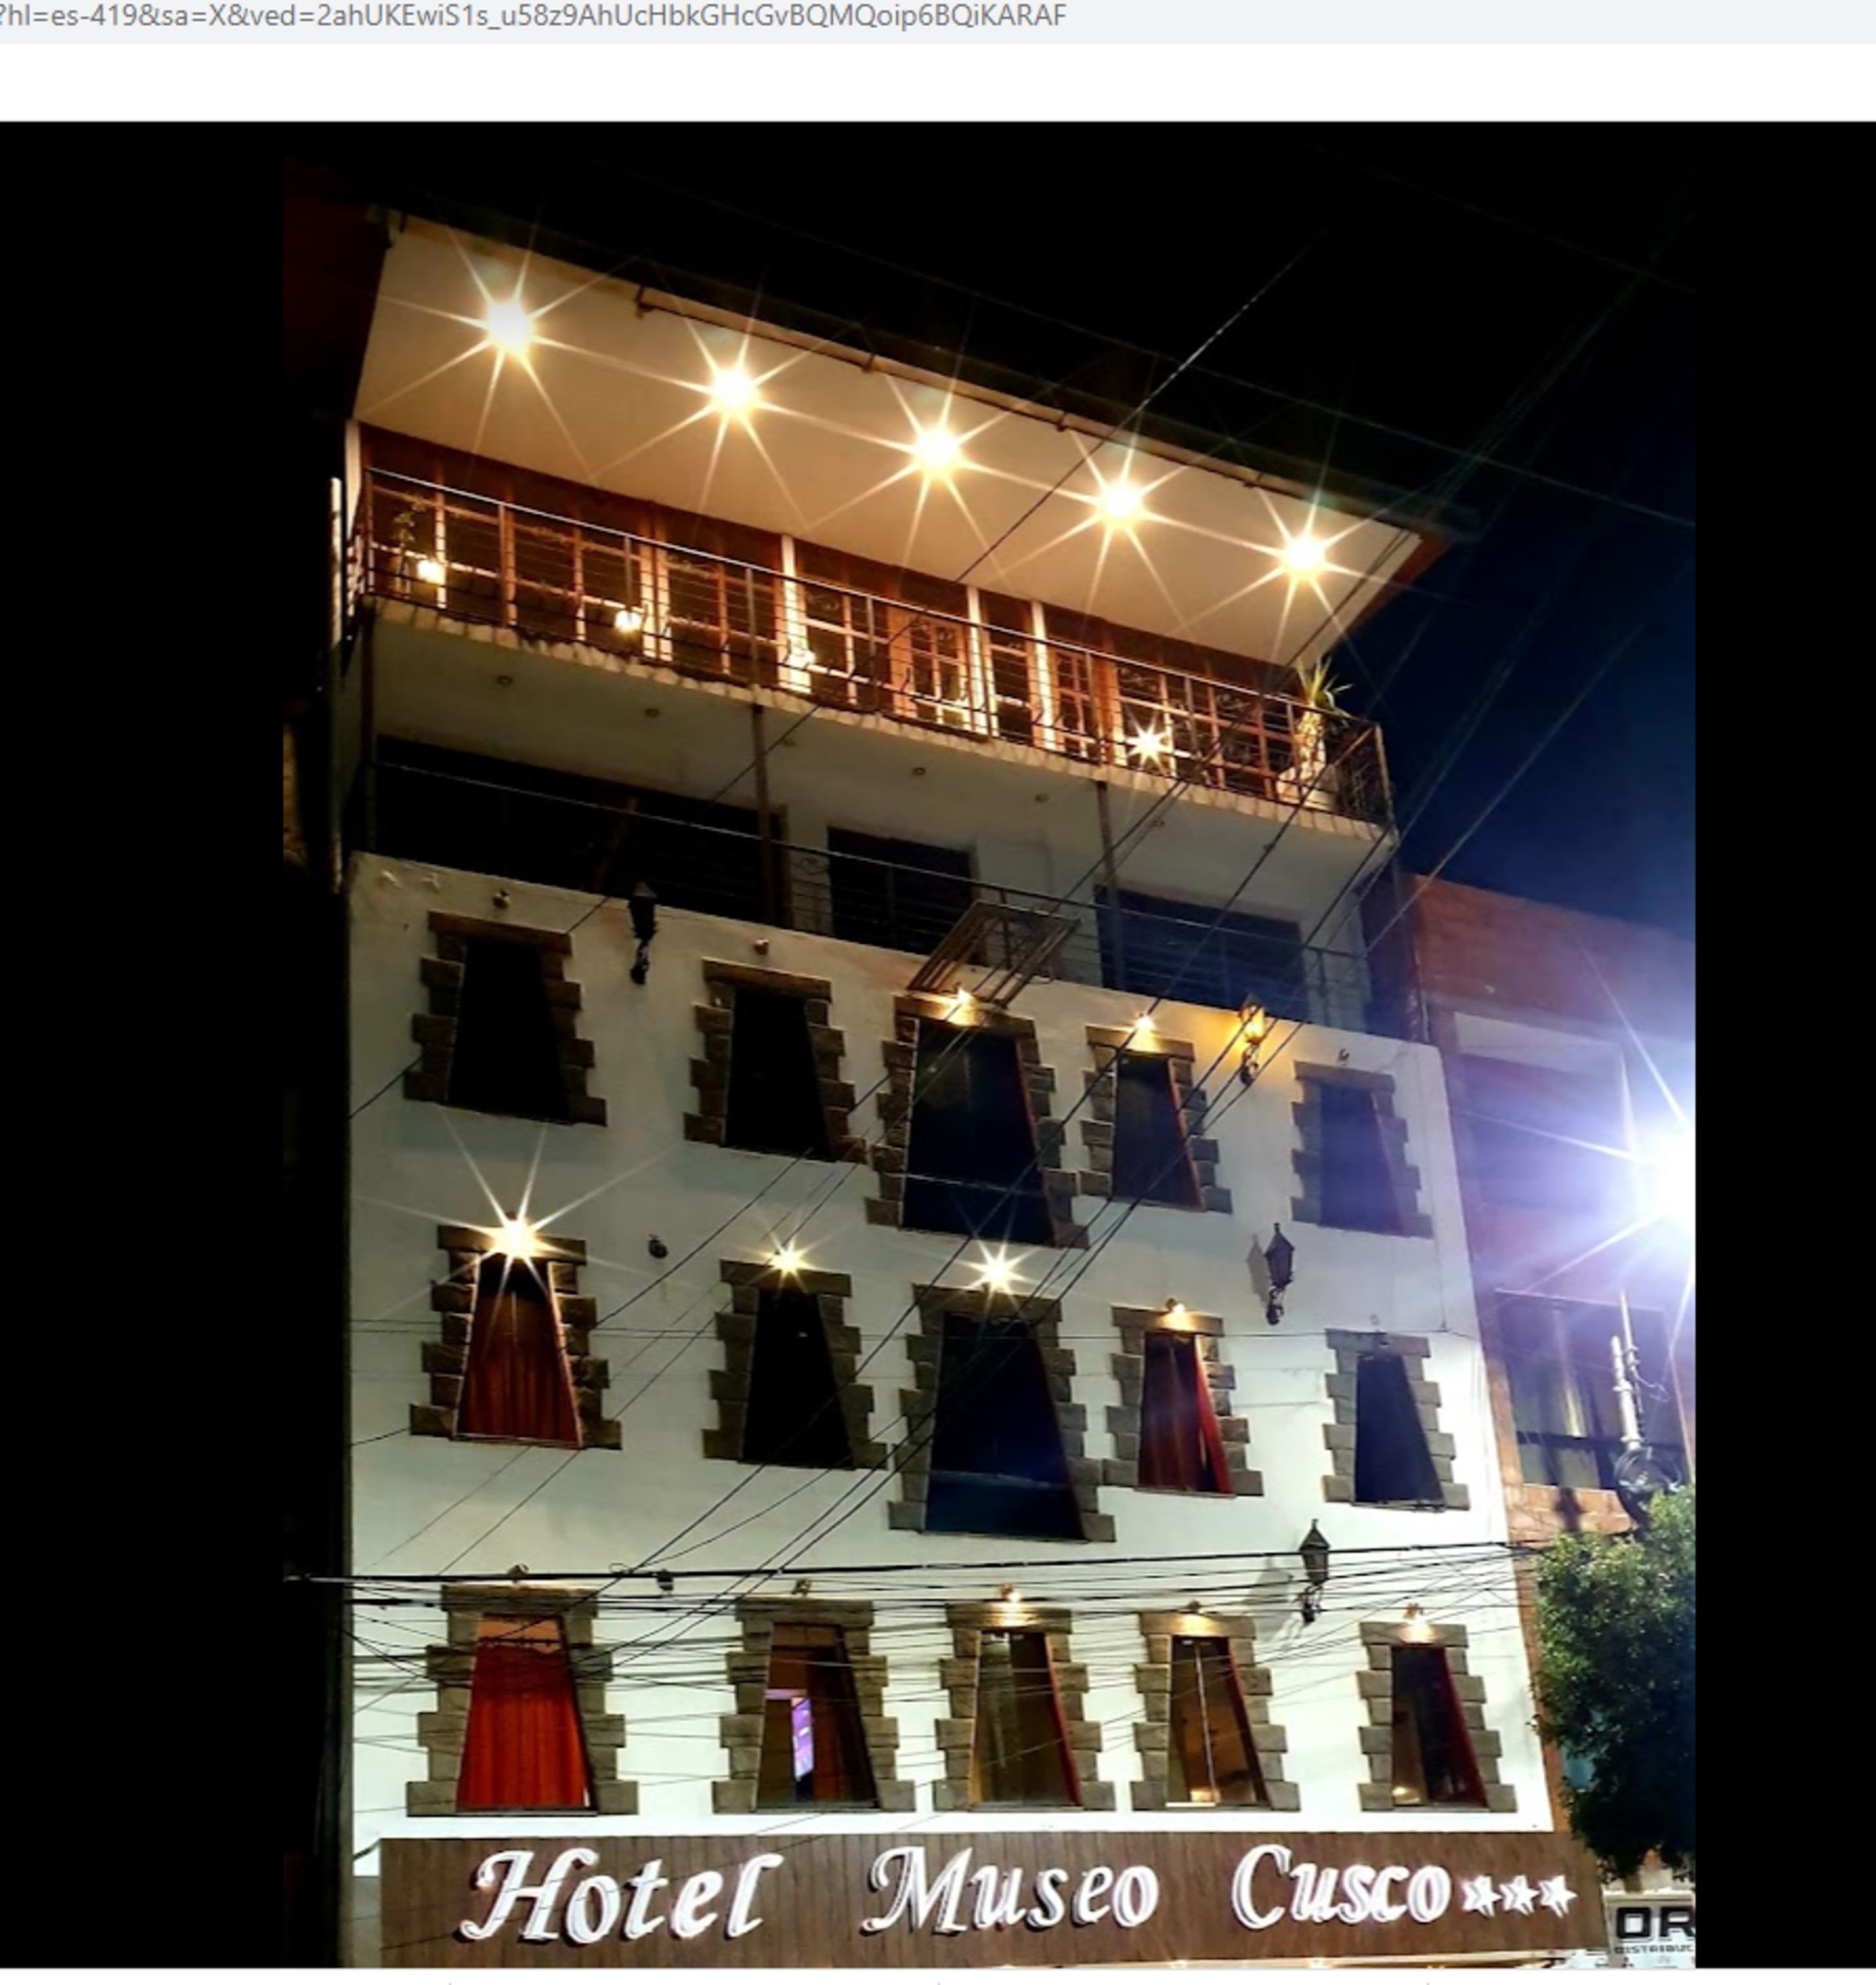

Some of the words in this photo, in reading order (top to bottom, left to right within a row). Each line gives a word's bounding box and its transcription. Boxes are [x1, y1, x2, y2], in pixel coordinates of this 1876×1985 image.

[458, 1846, 784, 1945] Hotel
[860, 1844, 1160, 1933] Museo
[1230, 1843, 1451, 1930] Cusco
